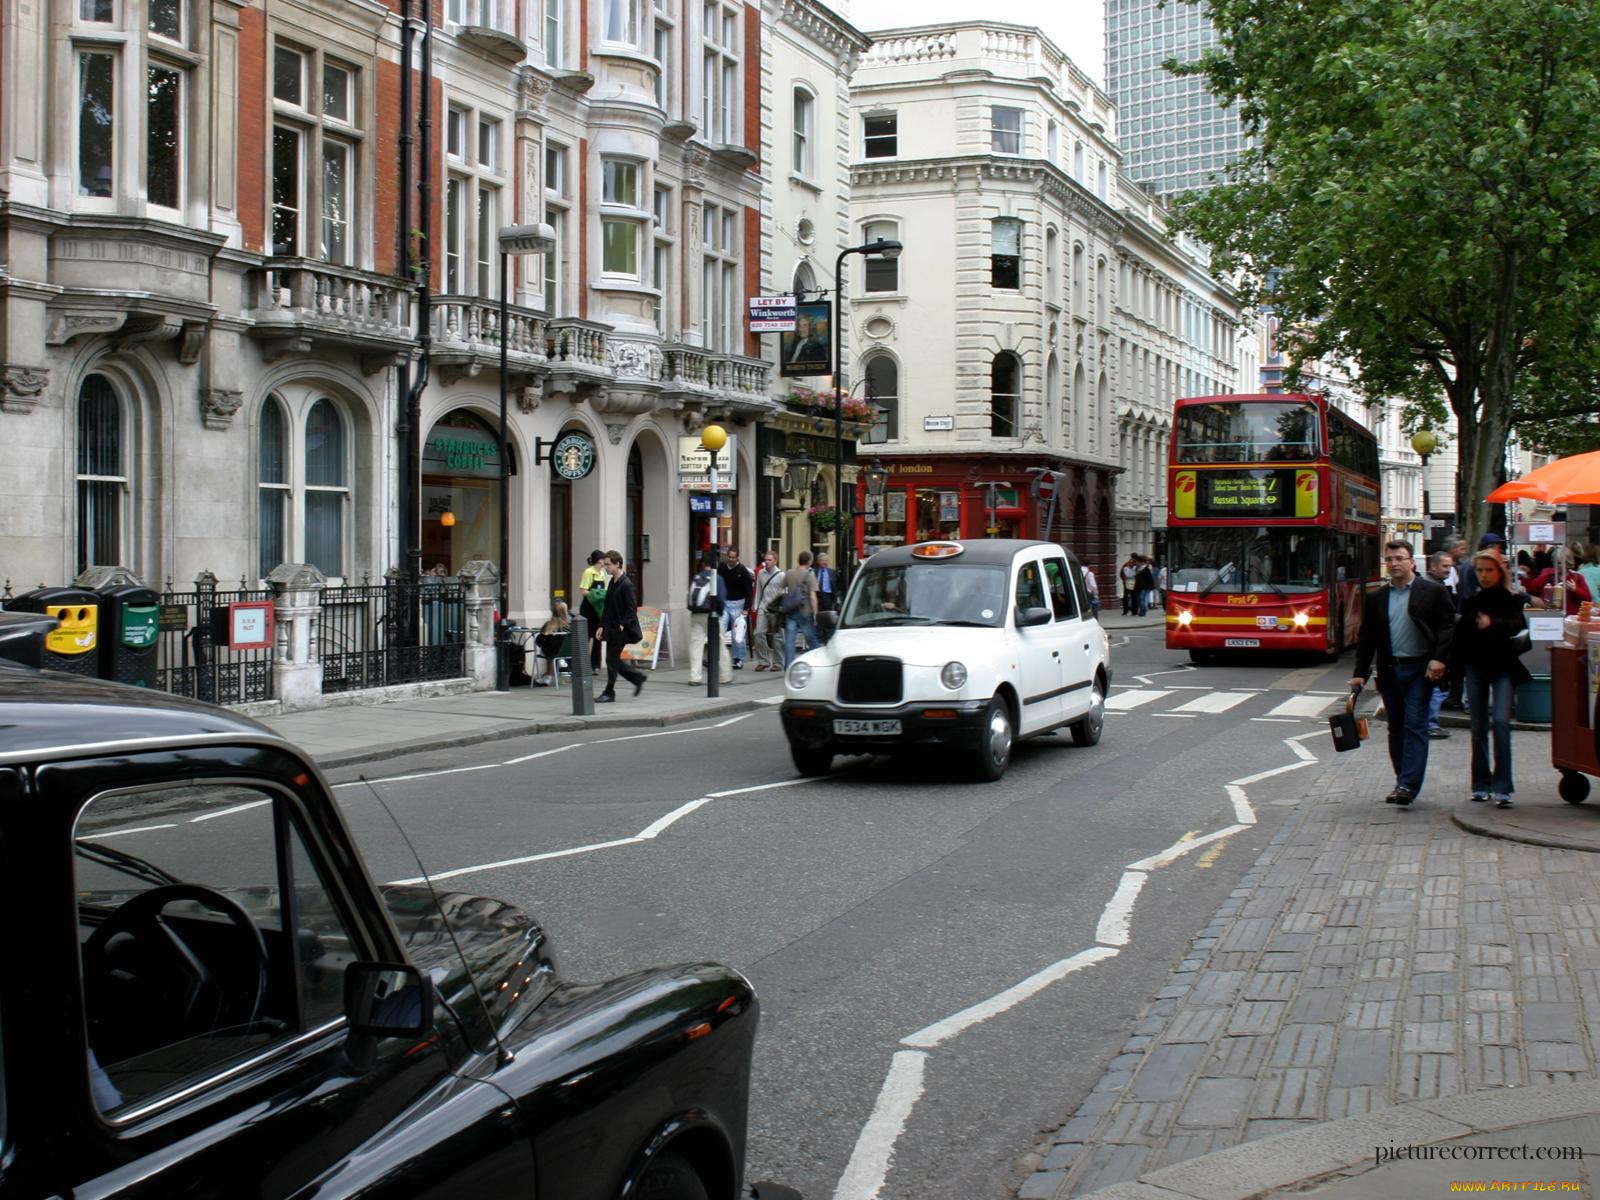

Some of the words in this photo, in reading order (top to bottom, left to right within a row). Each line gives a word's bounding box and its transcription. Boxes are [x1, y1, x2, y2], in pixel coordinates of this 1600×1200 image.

[750, 308, 796, 318] Winkworth
[433, 437, 498, 458] STARBUCKS
[556, 436, 592, 457] STARBUCKS
[447, 454, 486, 471] COFFEE
[899, 463, 933, 474] london
[559, 464, 587, 478] COFFEE
[1213, 495, 1239, 505] Russell
[1240, 496, 1265, 507] Square
[1227, 594, 1246, 605] First
[836, 720, 869, 733] T534
